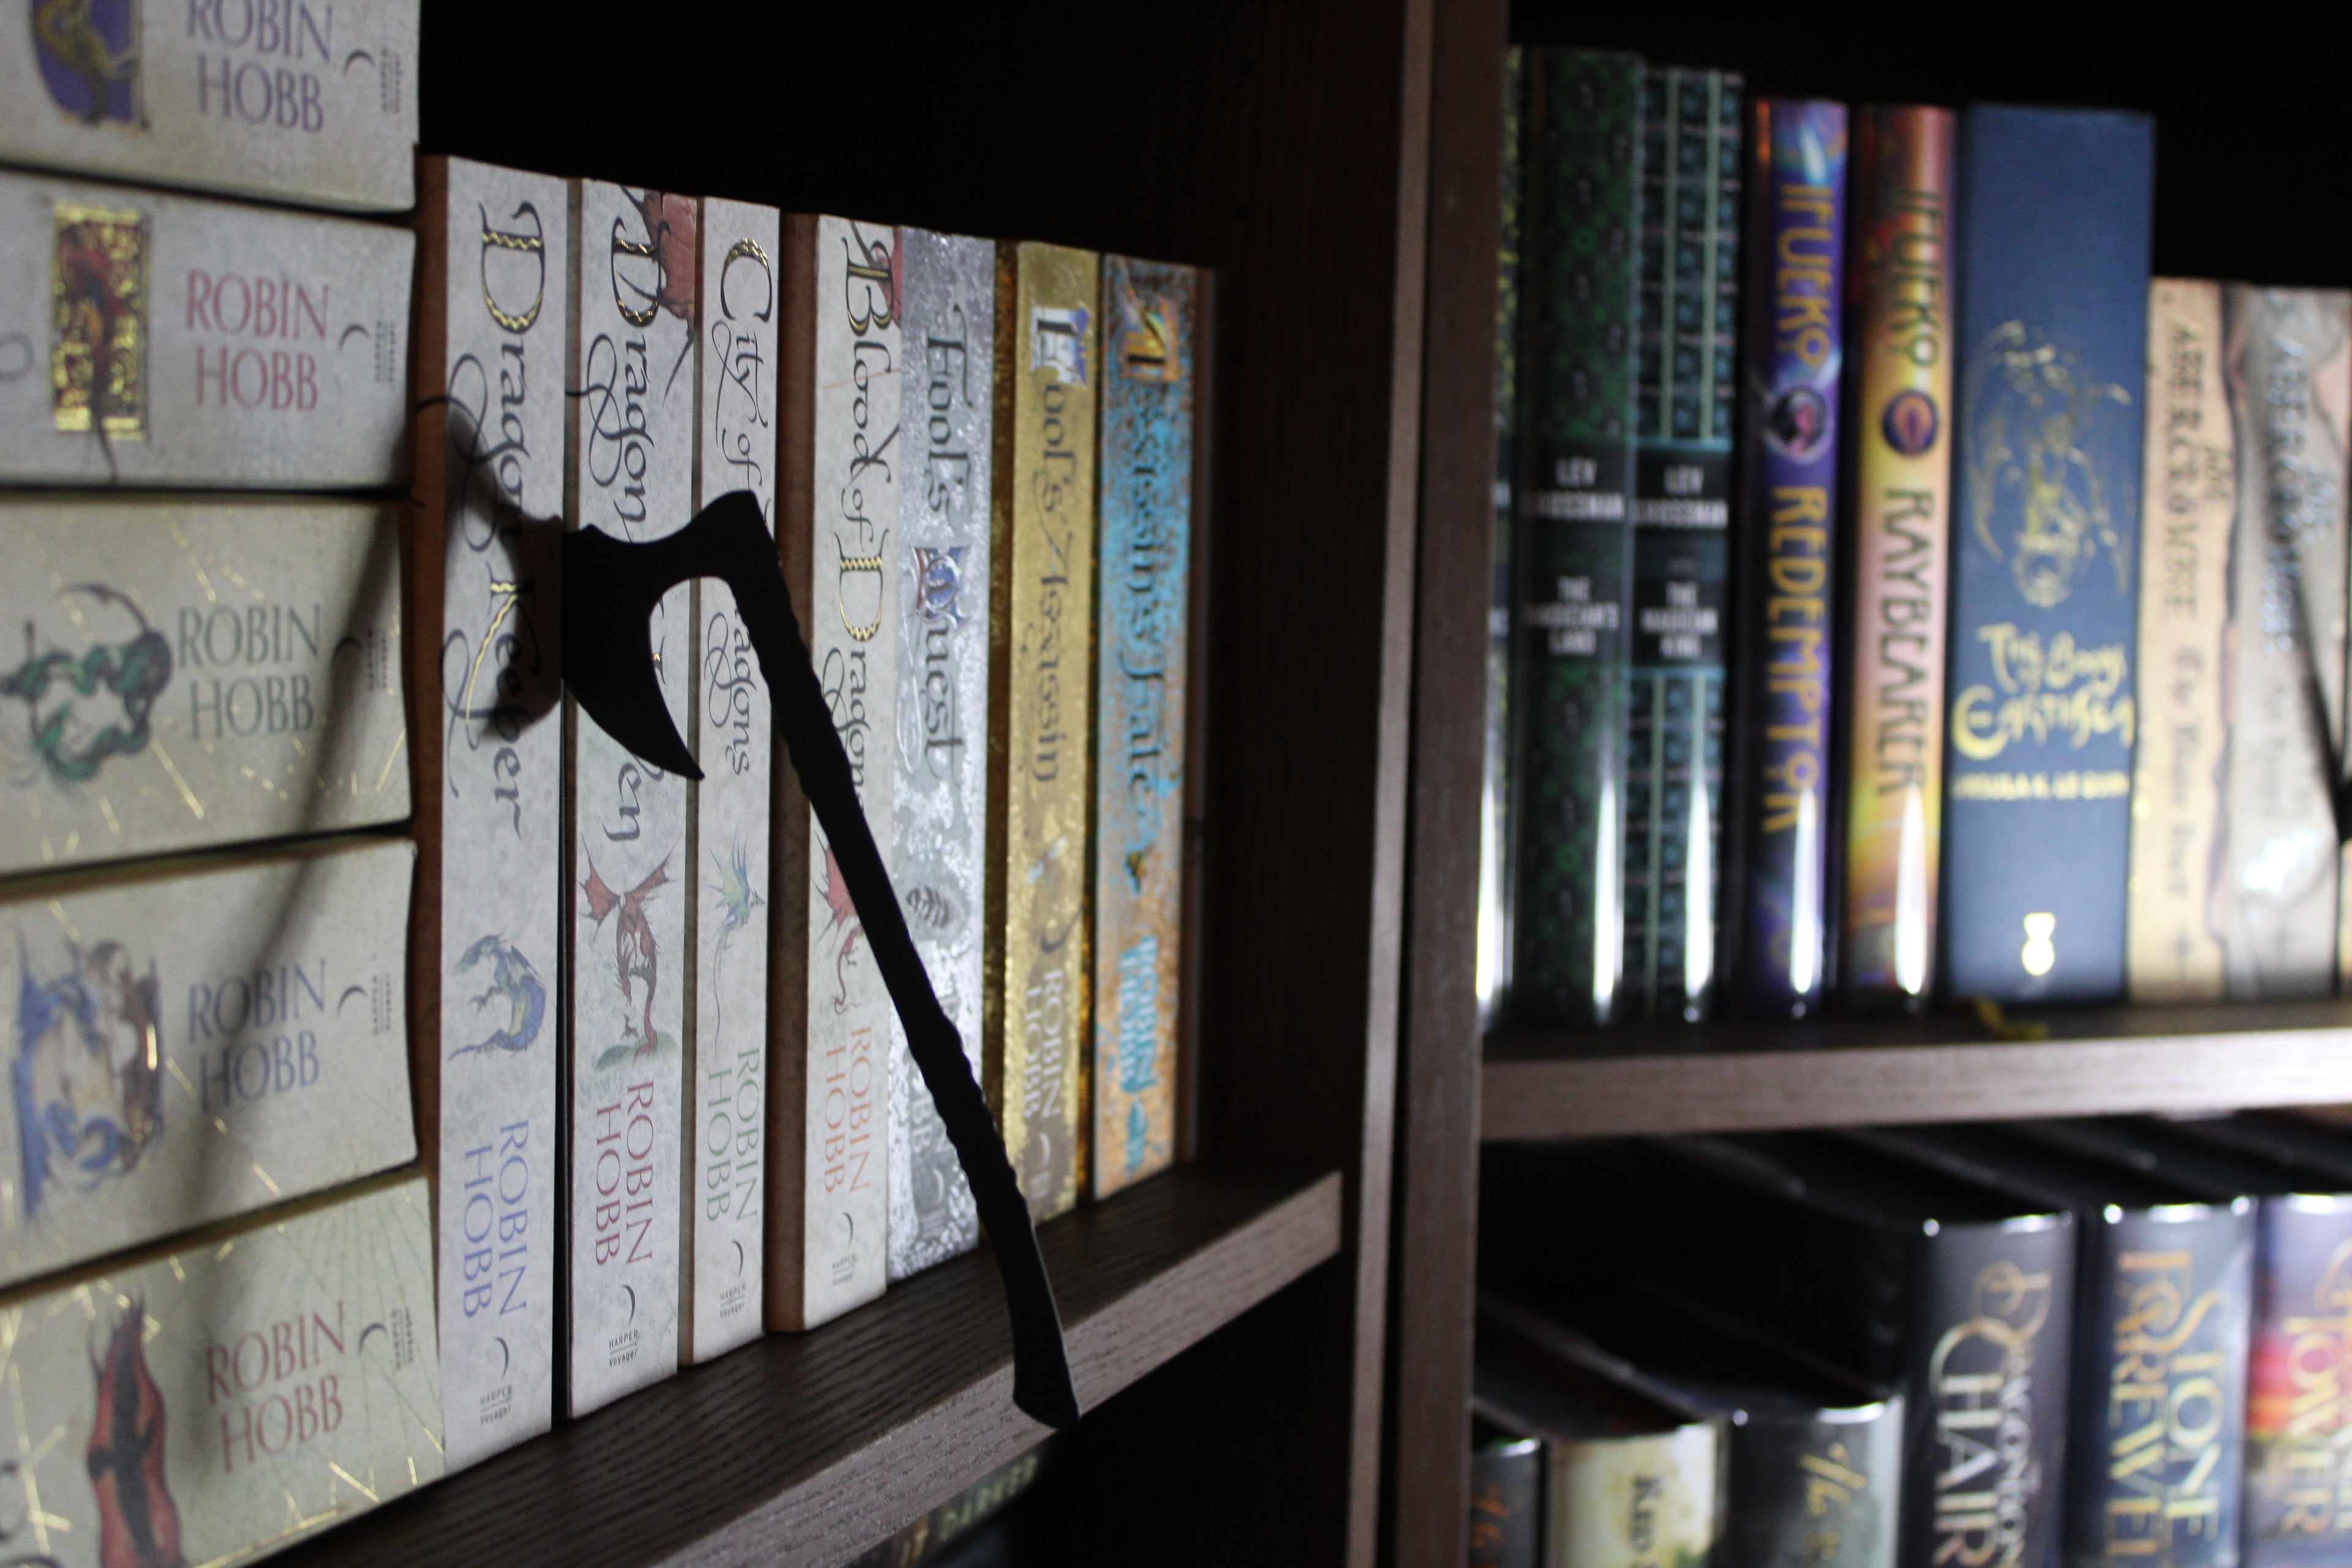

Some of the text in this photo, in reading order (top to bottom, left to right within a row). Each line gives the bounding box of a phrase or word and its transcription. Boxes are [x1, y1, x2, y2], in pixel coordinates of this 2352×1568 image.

[187, 0, 333, 62] ROBIN
[195, 54, 325, 133] HOBB
[186, 270, 329, 341] ROBIN
[195, 346, 319, 412] HOBB
[587, 218, 671, 543] Dragon
[843, 237, 894, 483] Blood
[706, 237, 772, 776] City of agons
[177, 604, 320, 669] ROBIN
[189, 676, 315, 743] HOBB
[187, 959, 328, 1046] ROBIN
[1023, 986, 1044, 1120] HOBB
[1042, 970, 1066, 1120] ROBIN
[199, 1031, 321, 1115] HOBB
[824, 1046, 846, 1193] HOBB
[850, 1026, 872, 1193] ROBIN
[595, 1103, 622, 1266] HOBB
[626, 1080, 655, 1265] ROBIN
[706, 1066, 733, 1222] HOBB
[735, 1047, 760, 1224] ROBIN
[462, 1145, 494, 1318] HOBB
[499, 1120, 529, 1317] ROBIN
[608, 1329, 639, 1351] HARPER
[719, 1283, 746, 1304] HARPER
[719, 1301, 746, 1319] Voyager
[205, 1301, 347, 1408] ROBIN
[608, 1349, 638, 1368] Voyager
[220, 1374, 345, 1472] HOBB
